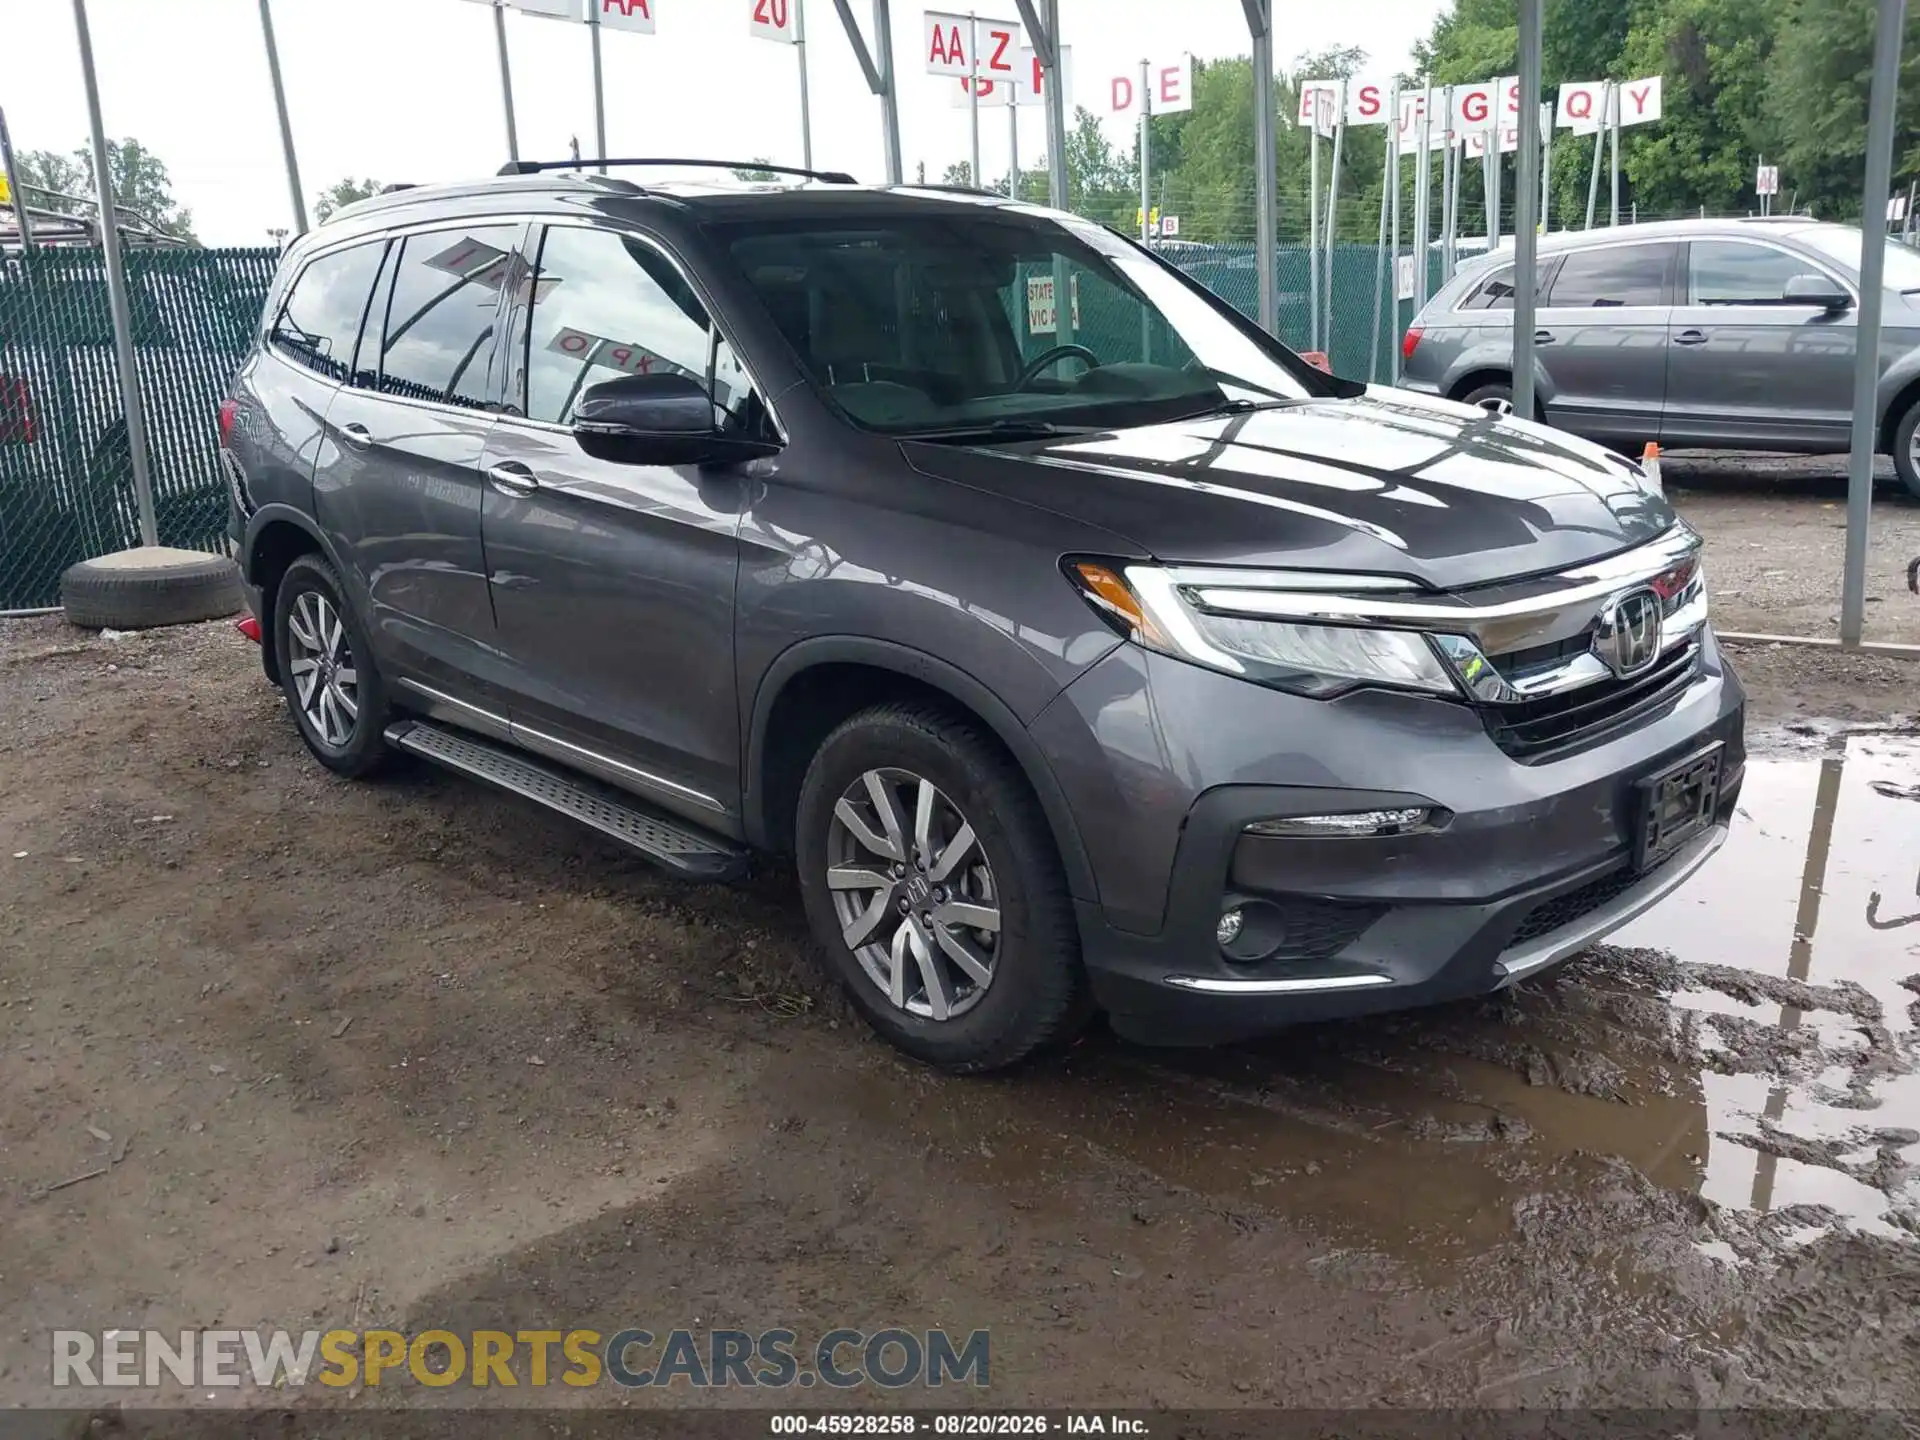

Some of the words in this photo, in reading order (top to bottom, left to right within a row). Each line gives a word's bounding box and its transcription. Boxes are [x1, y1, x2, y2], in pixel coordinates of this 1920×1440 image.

[930, 24, 965, 66] AA
[990, 31, 1011, 70] Z
[1112, 77, 1132, 111] D
[1161, 66, 1180, 103] E
[1359, 86, 1380, 115] S
[1462, 92, 1488, 121] G
[1567, 90, 1592, 119] Q
[1631, 86, 1650, 114] Y
[1030, 283, 1052, 300] STATE
